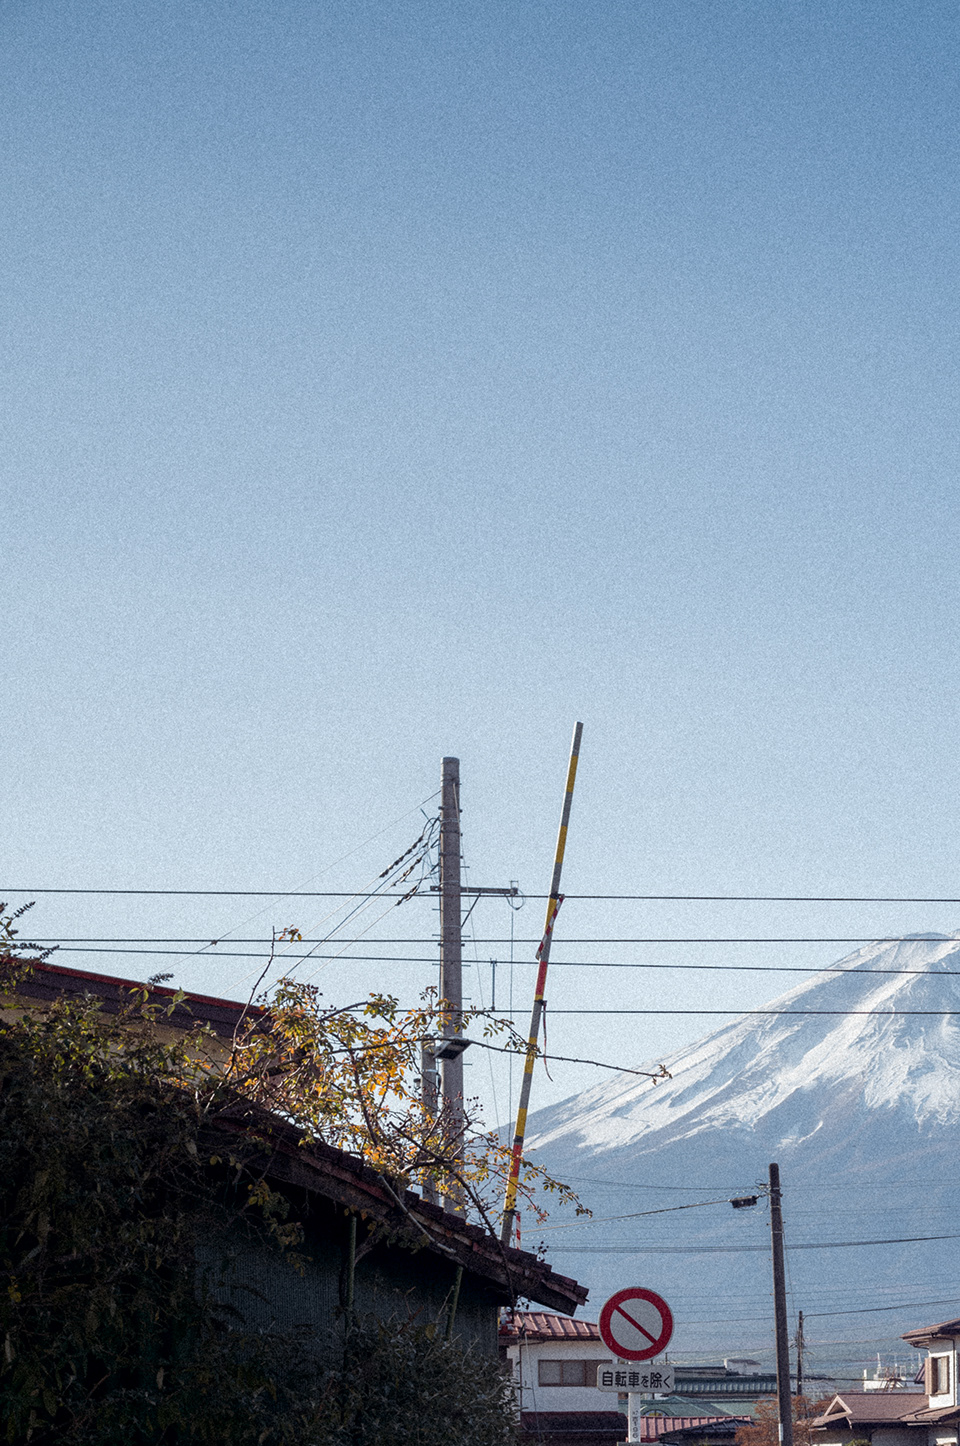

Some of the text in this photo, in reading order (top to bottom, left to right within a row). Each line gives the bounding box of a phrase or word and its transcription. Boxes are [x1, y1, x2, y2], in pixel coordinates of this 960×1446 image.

[602, 1370, 671, 1389] 自転車を除く
